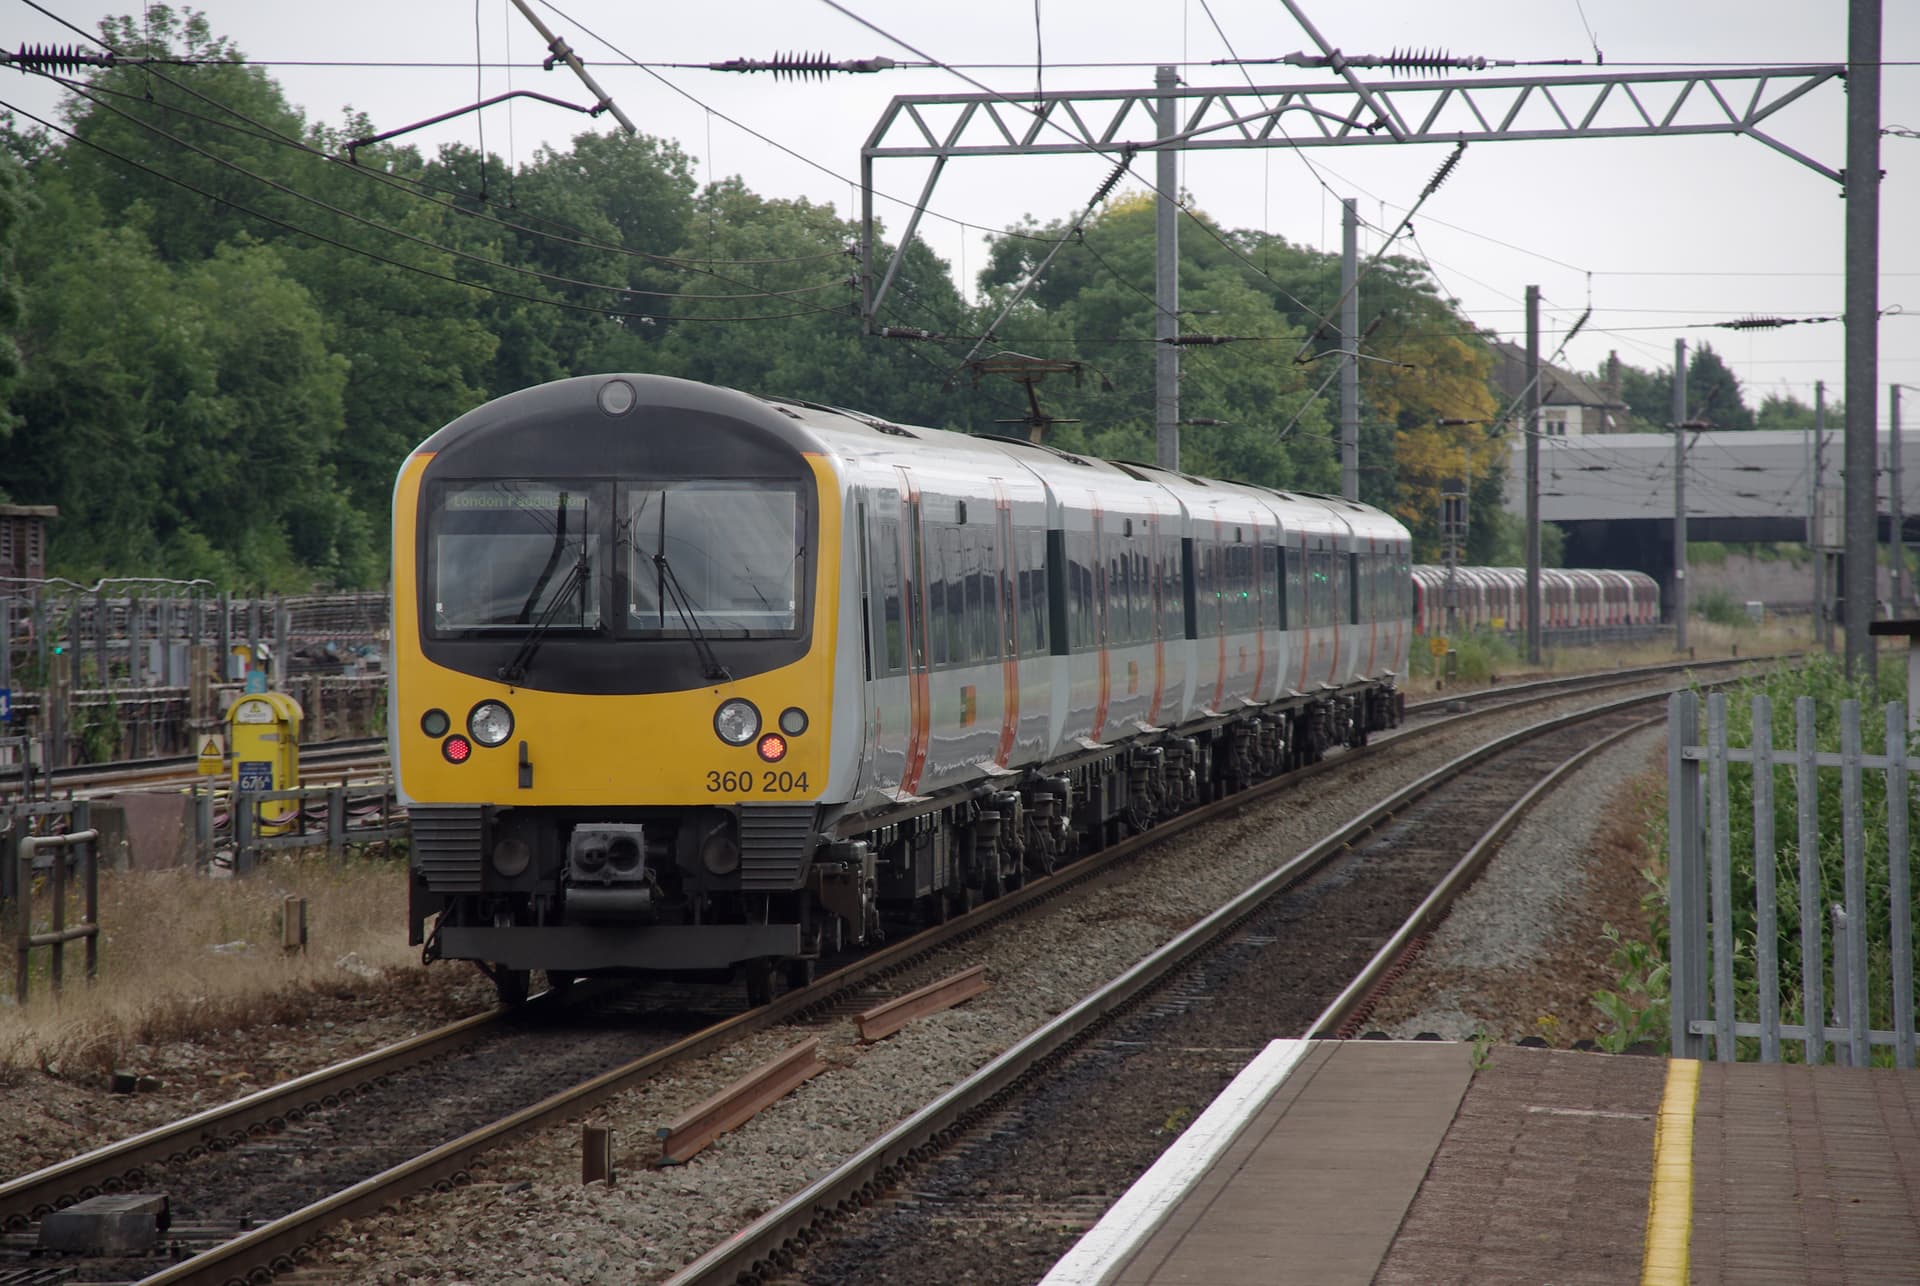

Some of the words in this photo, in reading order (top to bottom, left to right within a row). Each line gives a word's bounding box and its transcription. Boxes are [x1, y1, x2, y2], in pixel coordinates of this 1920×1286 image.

[454, 495, 504, 508] London
[706, 770, 753, 793] 360
[762, 770, 809, 793] 204
